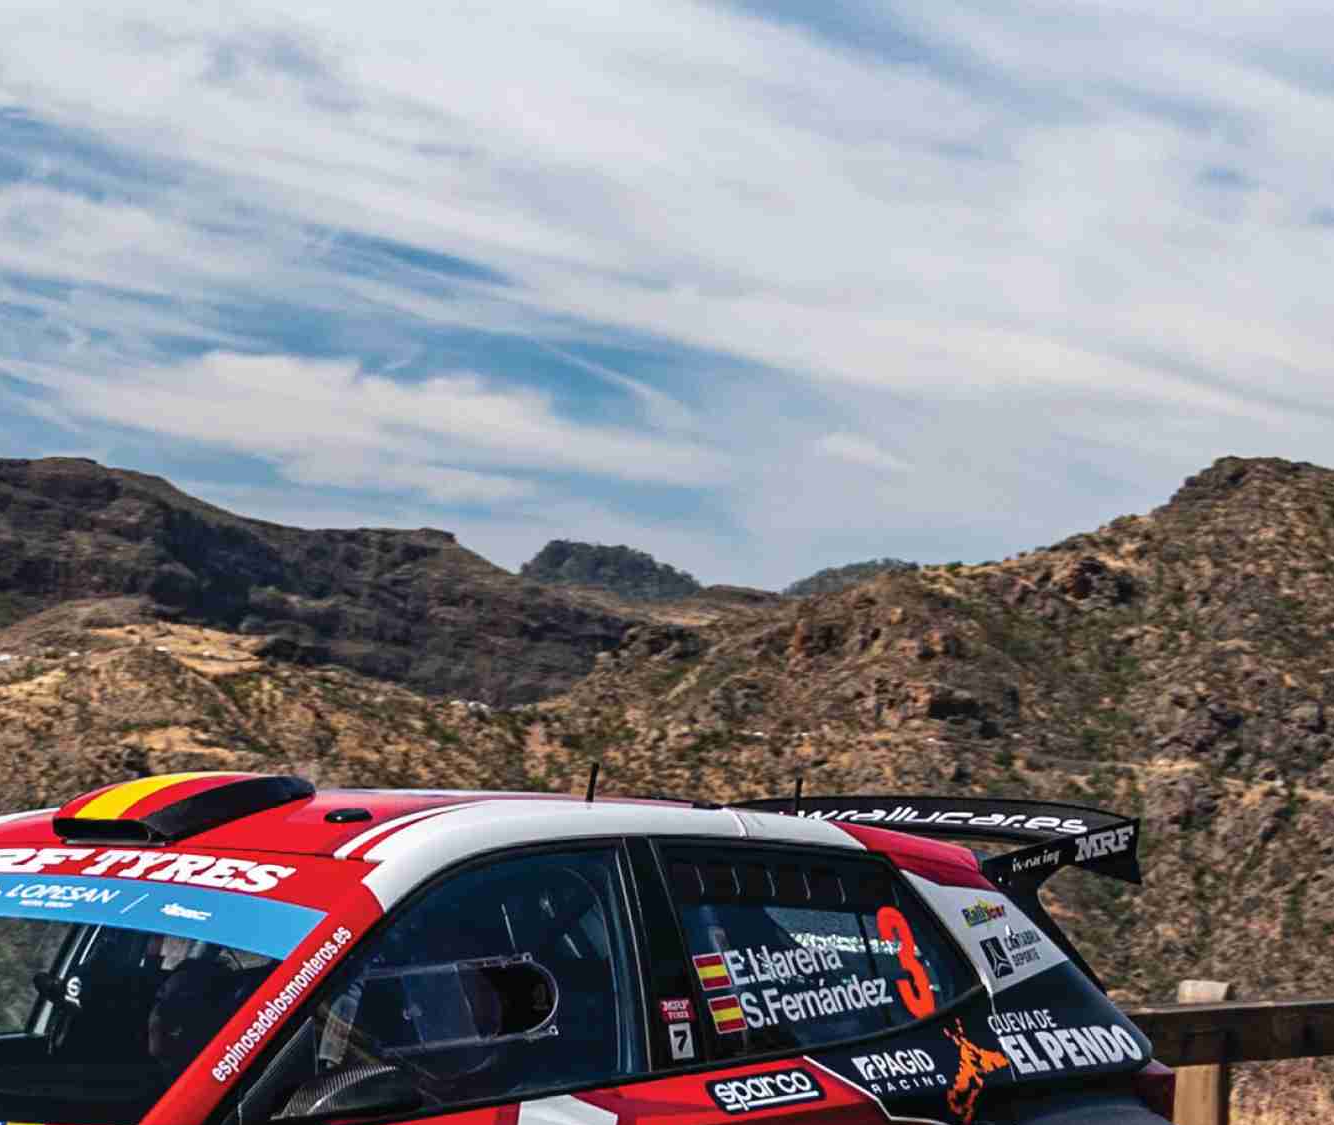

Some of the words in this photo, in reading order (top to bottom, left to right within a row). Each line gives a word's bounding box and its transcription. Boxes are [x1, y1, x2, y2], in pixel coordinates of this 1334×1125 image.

[1075, 825, 1134, 861] MRF
[81, 850, 297, 892] TYRES
[6, 884, 121, 904] LOPESAN
[876, 906, 936, 1020] 3
[212, 926, 352, 1082] espinosadelosmonteros.es
[740, 975, 894, 1029] S.Fernández
[987, 1011, 1038, 1034] CUEVA
[1033, 1009, 1058, 1030] DE
[673, 1030, 688, 1052] 7
[998, 1034, 1051, 1074] EL
[1035, 1024, 1143, 1069] PENDO
[873, 1049, 936, 1078] PAGID
[714, 1071, 813, 1111] sparco
[870, 1074, 948, 1094] RACING
